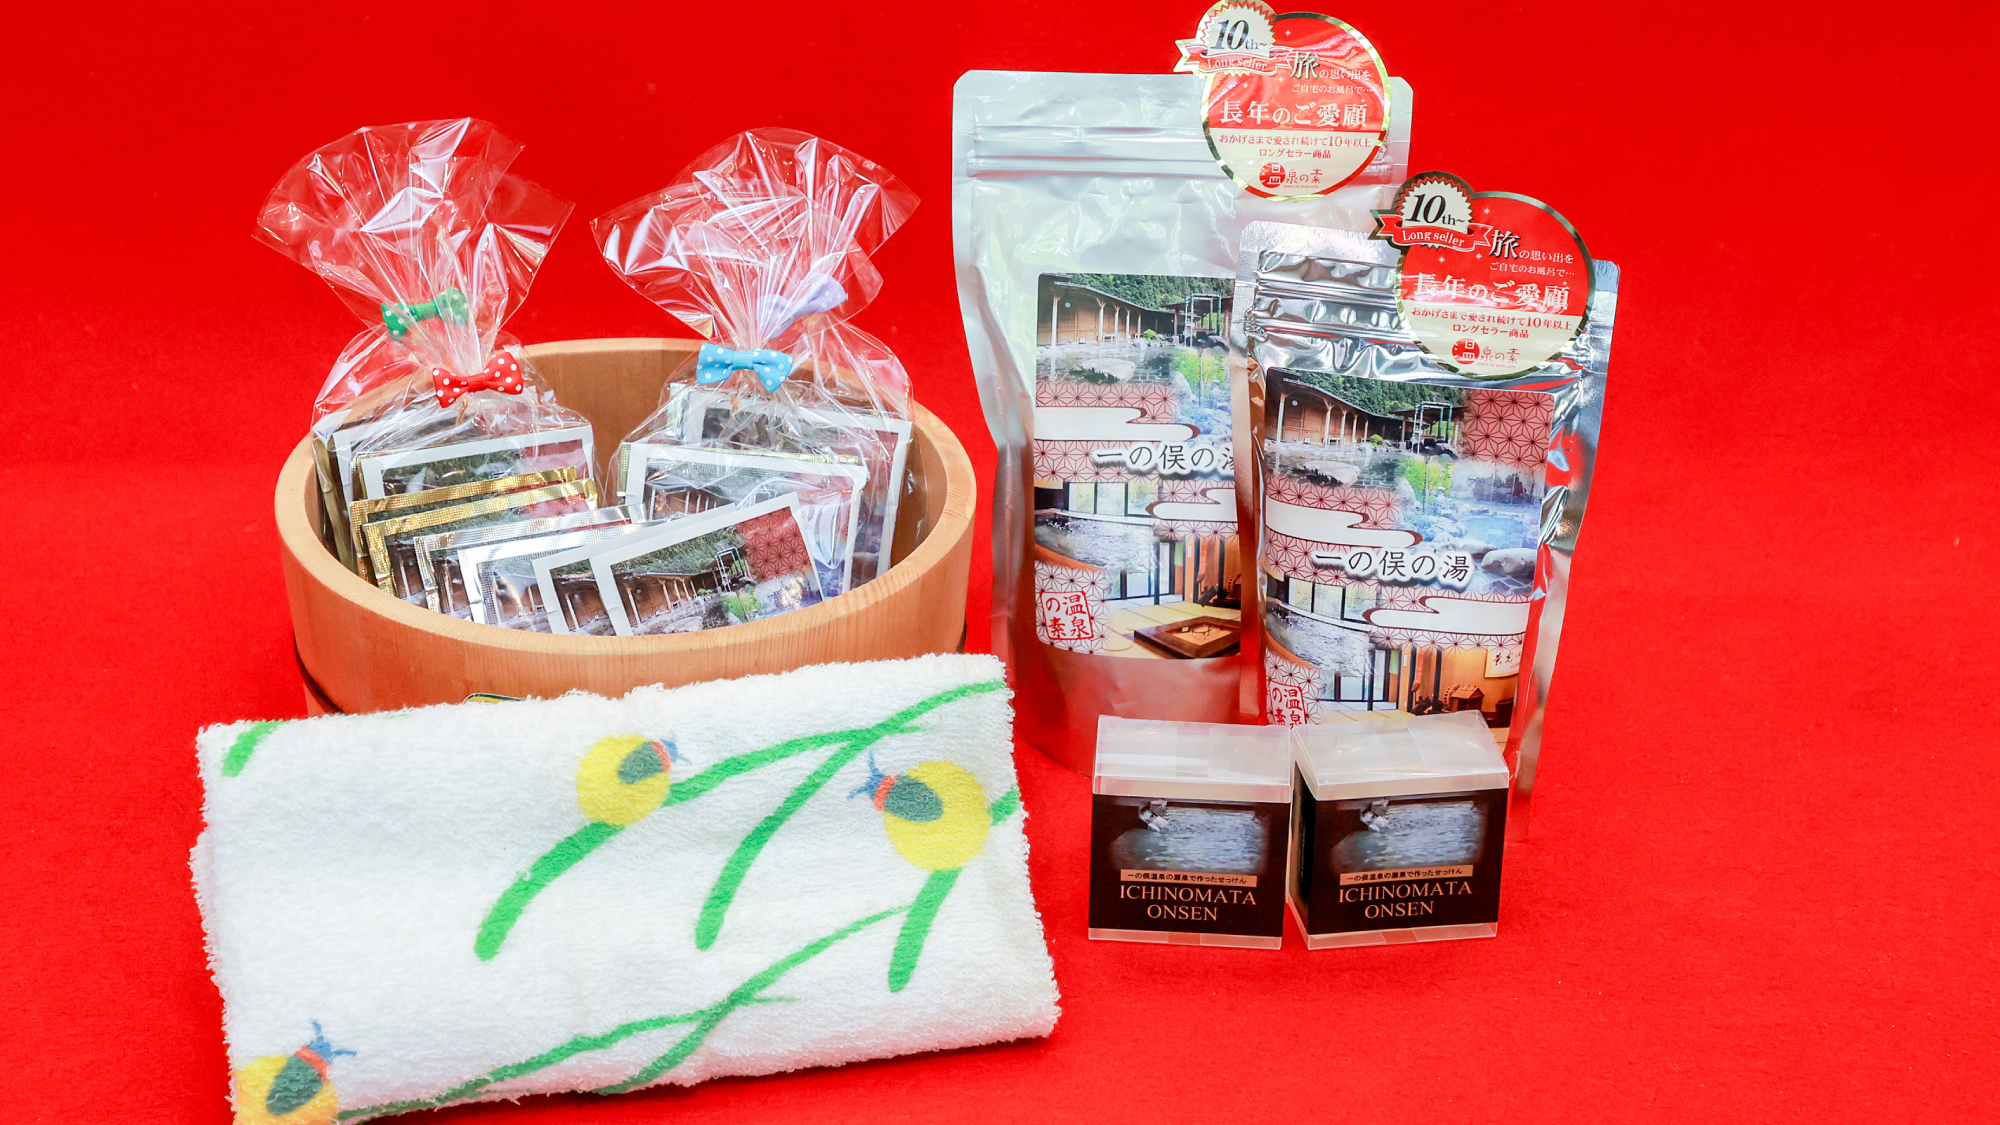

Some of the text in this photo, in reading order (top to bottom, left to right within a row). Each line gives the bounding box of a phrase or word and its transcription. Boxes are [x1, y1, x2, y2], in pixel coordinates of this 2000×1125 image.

[1207, 57, 1268, 71] Long seller
[1220, 99, 1368, 128] 長年のご愛顧
[1219, 134, 1371, 148] おかげさまで愛され続けて10年以上
[1259, 149, 1332, 159] ロングセラー商品
[1402, 229, 1465, 247] Long seller
[1414, 272, 1570, 310] 長年のご愛顧
[1411, 306, 1573, 331] おかげさまで愛され続けて10年以上
[1452, 323, 1530, 339] ロングセラー商品
[1315, 550, 1470, 582] 一の俣の湯
[1120, 885, 1257, 905] ICHINOMATA
[1339, 881, 1472, 903] ICHINOMATA
[1147, 904, 1218, 921] ONSEN
[1364, 900, 1434, 919] ONSEN
